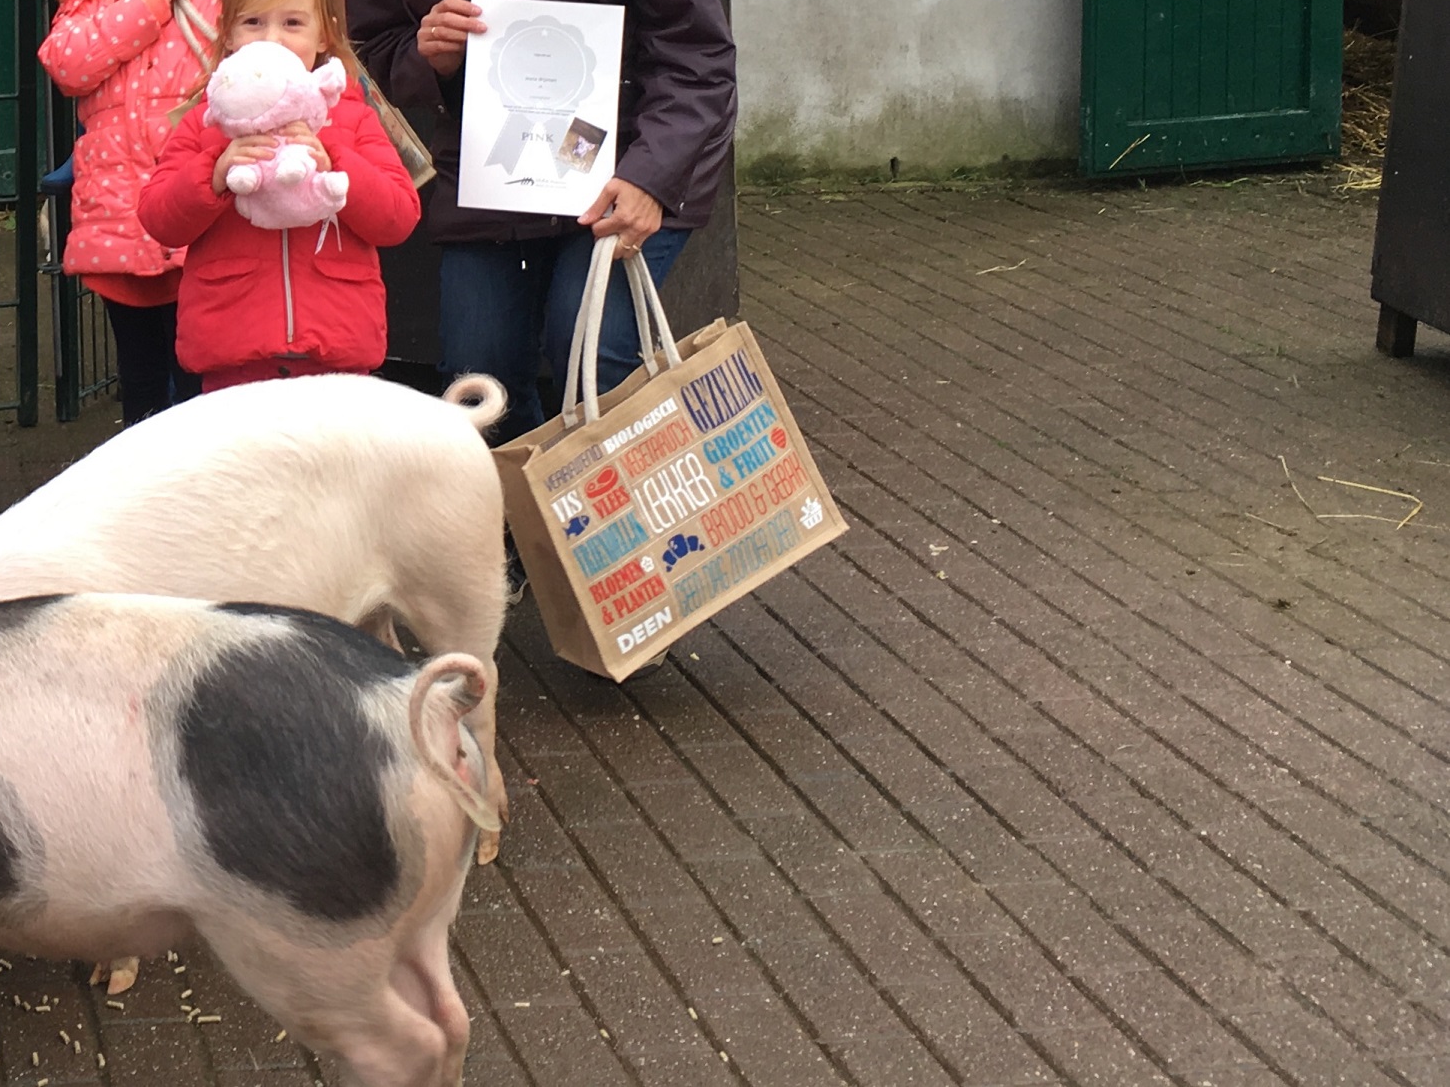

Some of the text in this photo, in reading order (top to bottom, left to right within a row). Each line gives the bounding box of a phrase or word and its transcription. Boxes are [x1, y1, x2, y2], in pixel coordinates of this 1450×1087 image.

[521, 132, 554, 143] PINK
[680, 348, 764, 434] GEZELLIG
[602, 397, 678, 454] BIOLOGISCH
[702, 400, 778, 465] GROENTEN
[718, 434, 777, 490] & FRUIT
[551, 490, 583, 523] VIS
[592, 485, 631, 520] VLEES
[634, 452, 718, 534] LEKKER
[700, 451, 808, 548] BROOD & GEBAK
[589, 557, 646, 606] BLOEMEN
[612, 573, 667, 619] PLANTEN
[616, 606, 673, 655] DEEN
